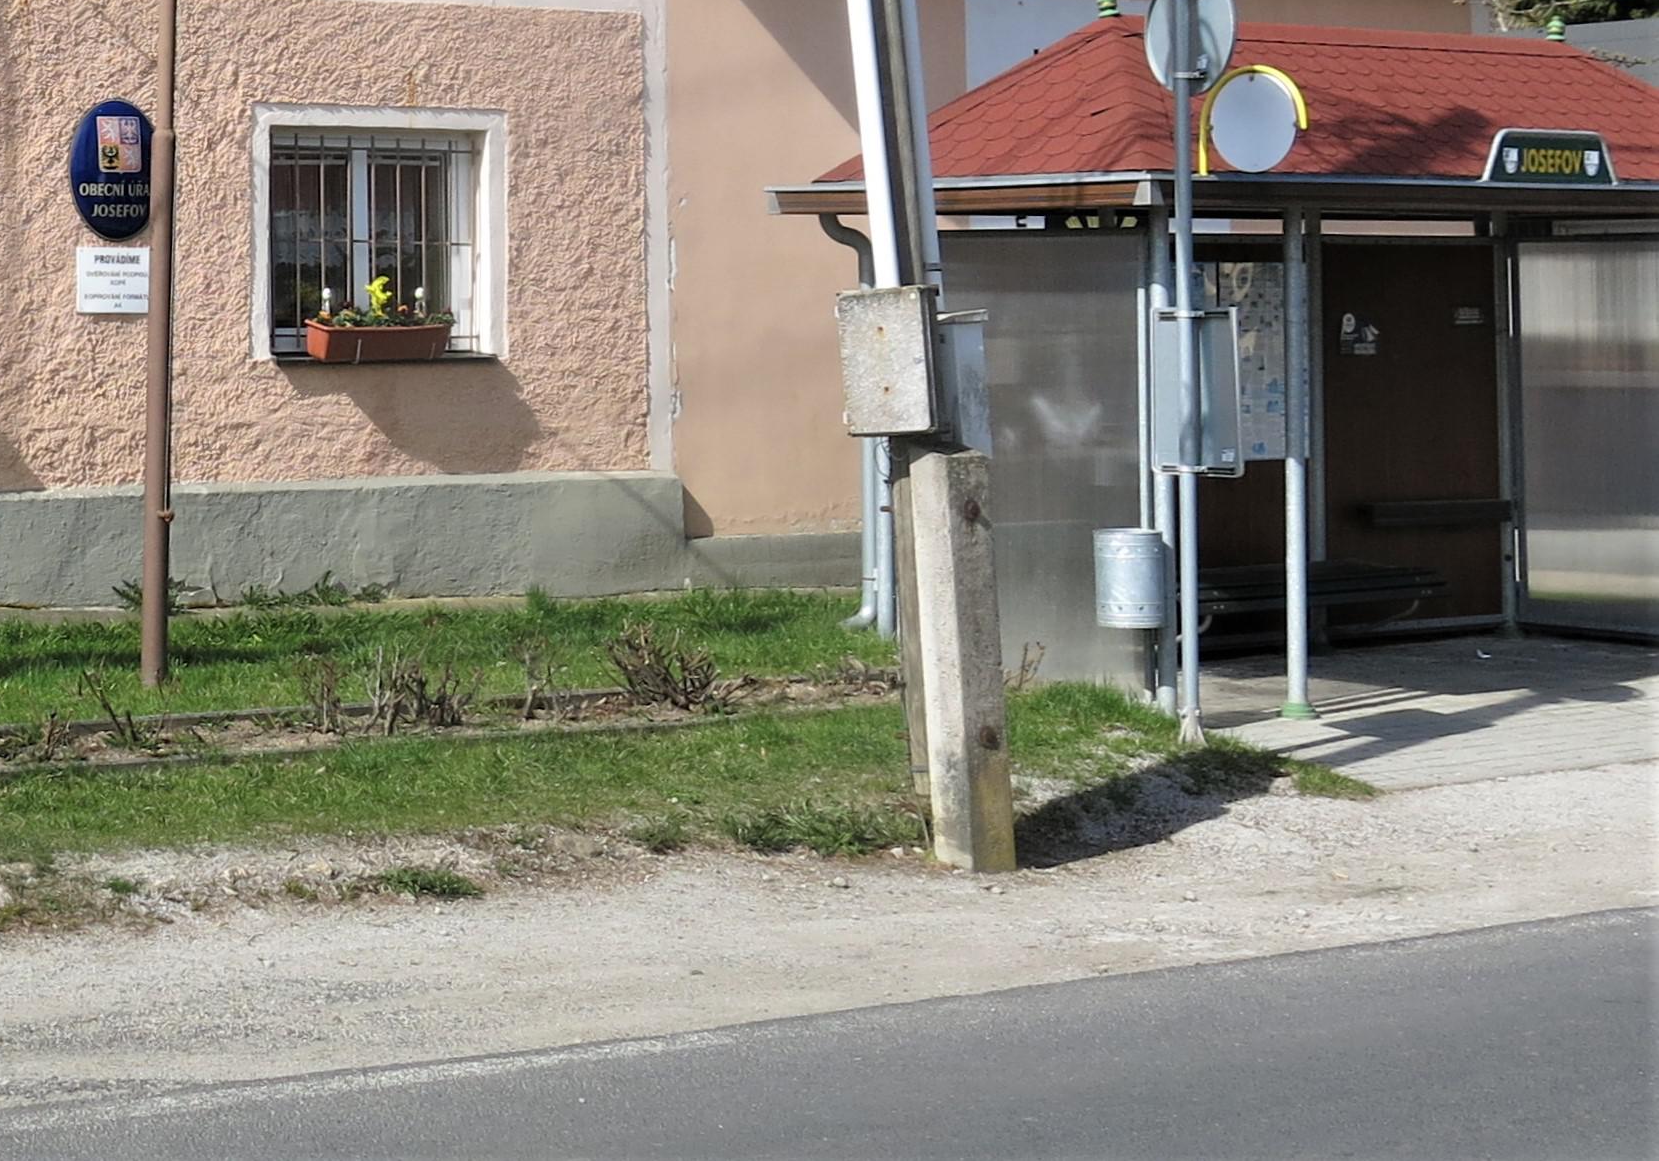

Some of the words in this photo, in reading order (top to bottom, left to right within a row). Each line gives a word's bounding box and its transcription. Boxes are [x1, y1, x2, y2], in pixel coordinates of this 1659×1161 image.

[1521, 148, 1582, 174] JOSEFOV
[79, 181, 125, 196] OBECNÍ
[128, 181, 150, 197] ÚŘA
[92, 204, 147, 218] JOSEFOV
[94, 253, 141, 264] PROVÁDÍME
